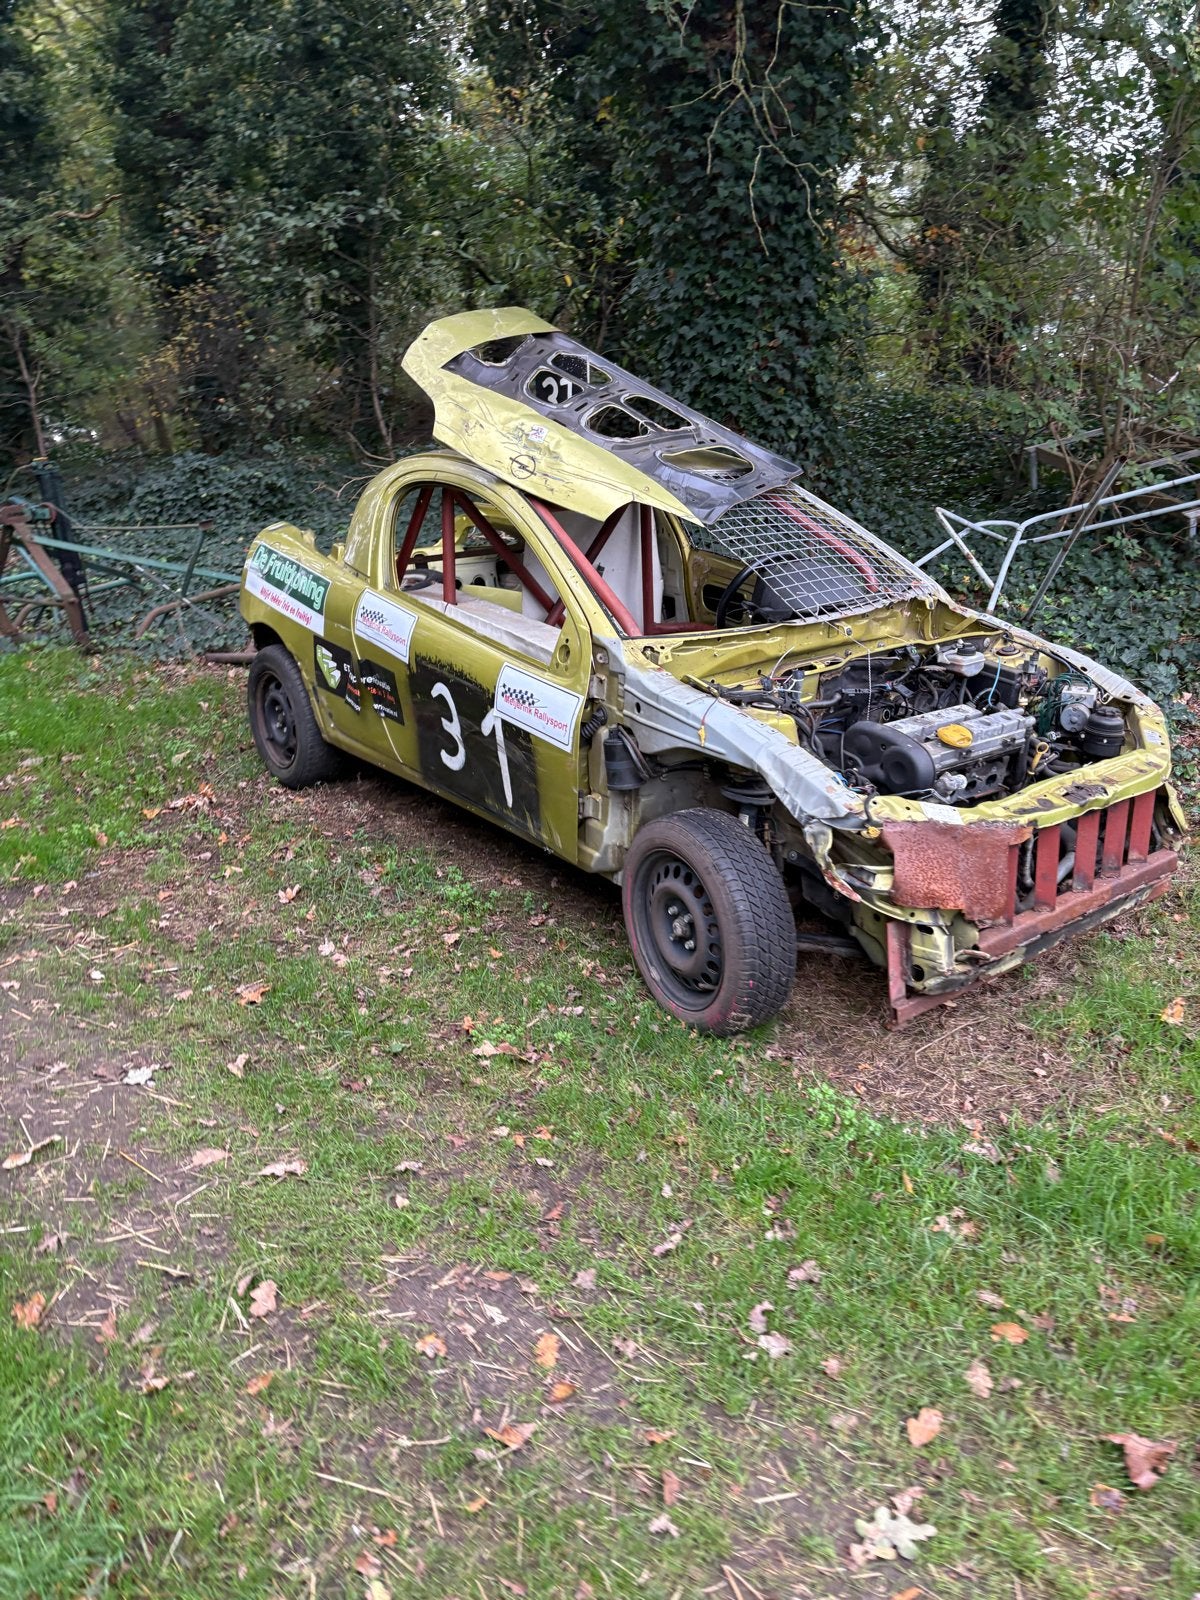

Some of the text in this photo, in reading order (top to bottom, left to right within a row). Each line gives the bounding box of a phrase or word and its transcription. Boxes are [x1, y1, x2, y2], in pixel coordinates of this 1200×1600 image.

[253, 546, 269, 571] De
[503, 694, 568, 731] Meijerink Rallysport
[430, 682, 513, 808] 31
